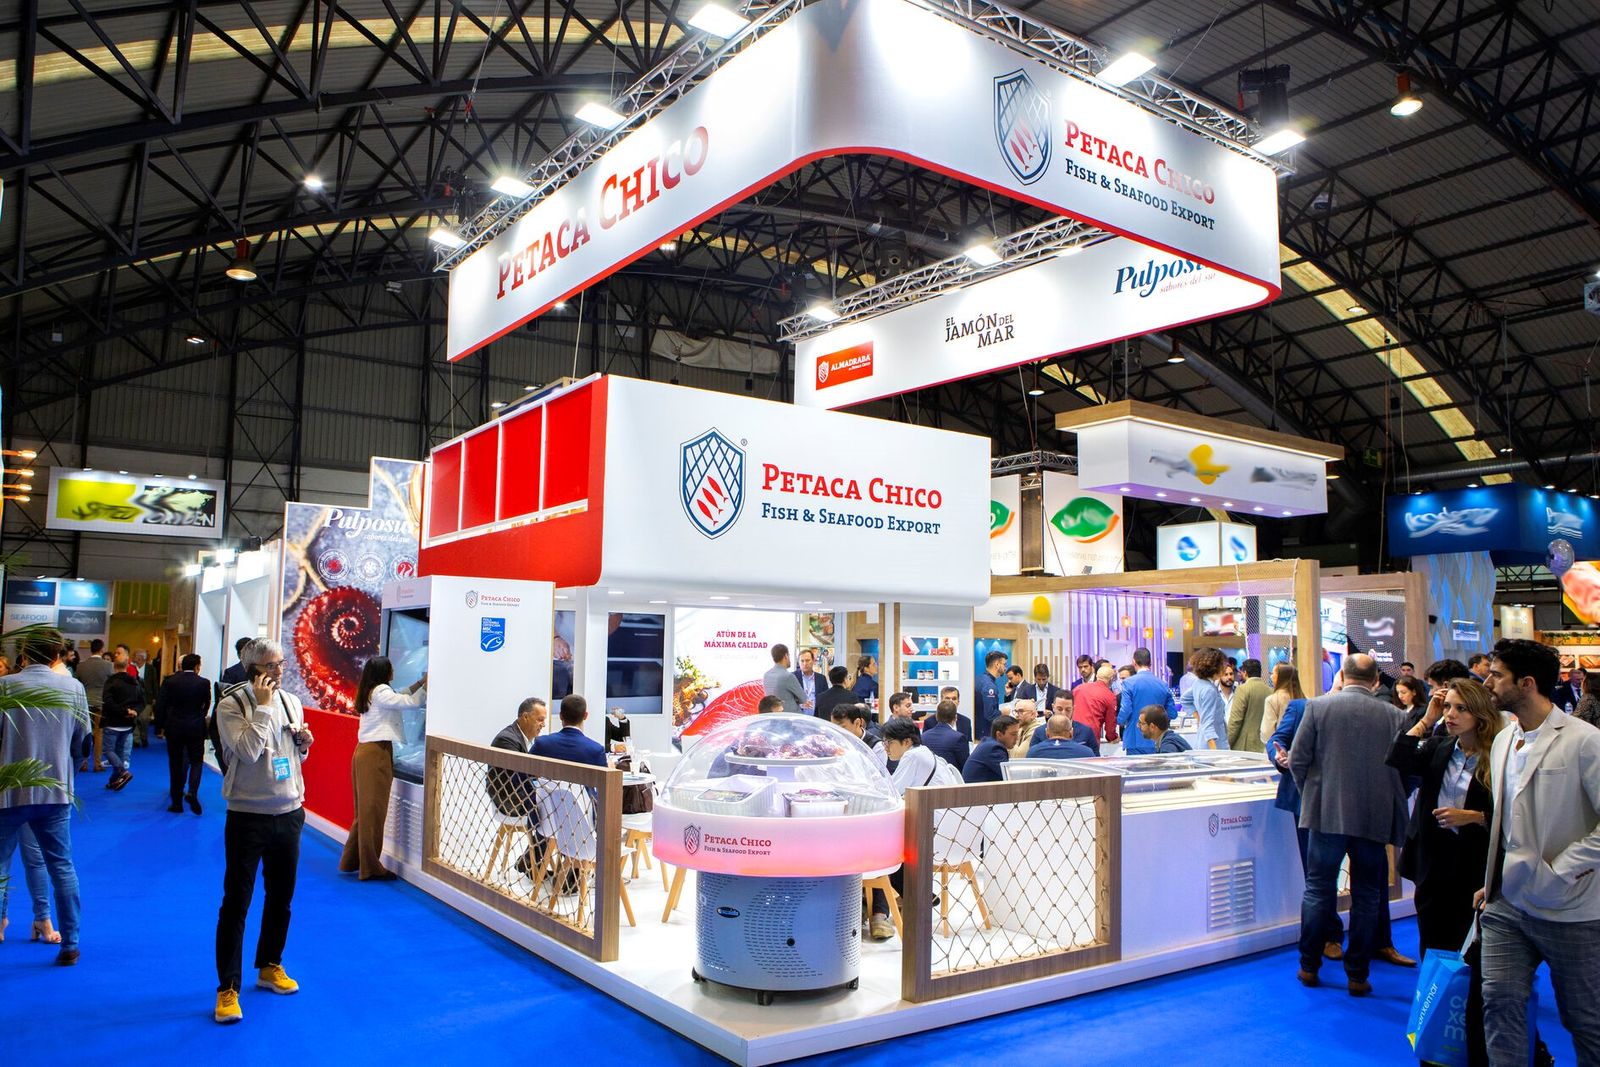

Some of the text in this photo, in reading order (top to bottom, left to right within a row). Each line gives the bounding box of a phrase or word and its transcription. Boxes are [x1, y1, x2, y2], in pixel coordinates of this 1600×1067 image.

[1064, 119, 1215, 204] PETACA CHICO
[1065, 158, 1215, 230] FISH & SEAFOOD EXPORT
[497, 126, 709, 300] PETACA CHICO
[1113, 259, 1204, 298] Pulpos
[945, 313, 1014, 342] JAMÓN DEL
[946, 317, 955, 326] EL
[977, 324, 1015, 348] MAR
[831, 354, 871, 371] ALMADRABA
[762, 463, 942, 509] PETACA CHICO
[761, 502, 941, 534] FISH & SEAFOOD EXPORT
[704, 639, 768, 649] MÁXIMA CALIDAD
[716, 629, 736, 638] ATÚN
[704, 834, 772, 847] PETACA CHICO
[722, 847, 747, 855] SEAFOOD
[1443, 1023, 1467, 1041] m
